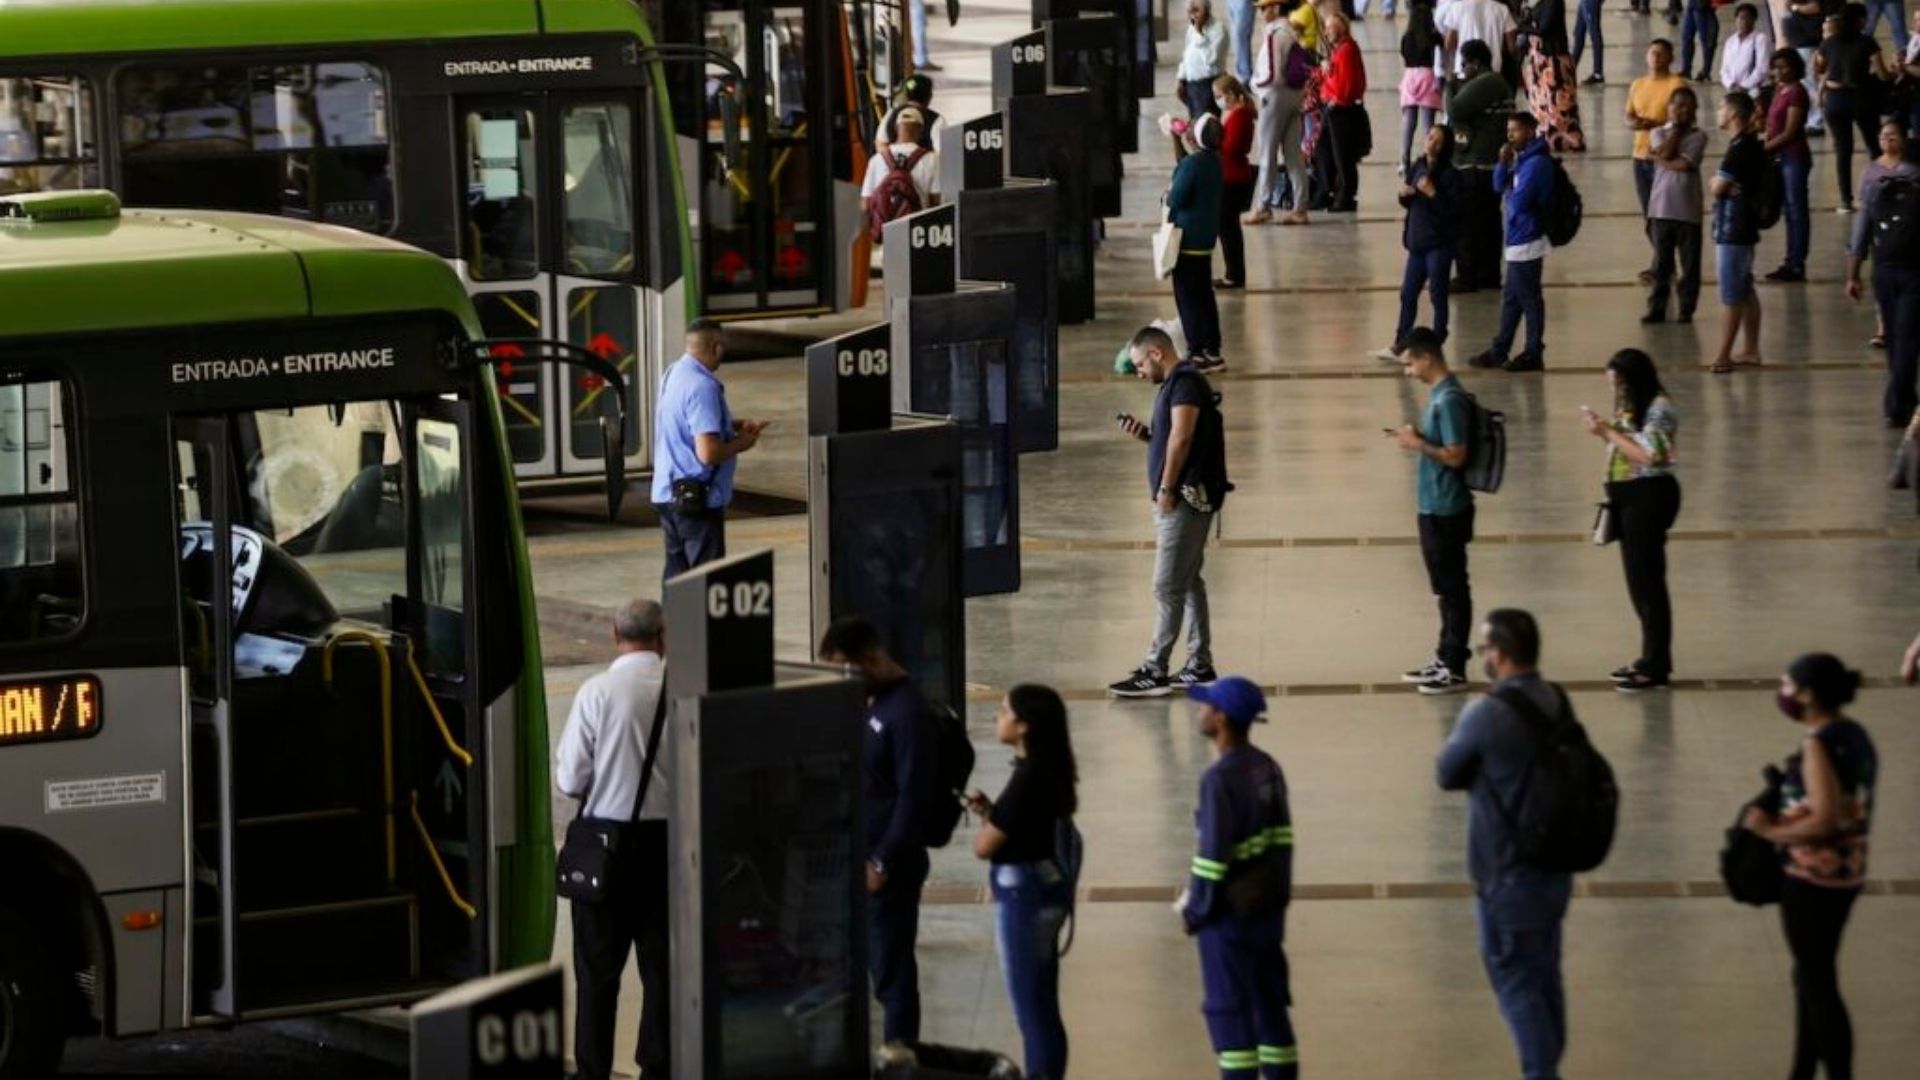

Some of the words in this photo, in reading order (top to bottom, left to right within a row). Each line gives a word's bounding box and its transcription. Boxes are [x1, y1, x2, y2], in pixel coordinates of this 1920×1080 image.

[444, 60, 511, 76] ENTRADA
[517, 56, 592, 73] ENTRANCE
[1012, 45, 1023, 63] C
[1025, 44, 1045, 62] 06
[965, 130, 977, 150] C
[980, 129, 1002, 149] 05
[912, 226, 925, 248] C
[928, 224, 953, 247] 04
[171, 357, 270, 382] ENTRADA
[283, 348, 394, 374] ENTRANCE
[838, 350, 853, 376] C
[859, 348, 888, 375] 03
[708, 583, 728, 617] C
[733, 581, 770, 616] 02
[0, 686, 43, 735] AN
[478, 1015, 506, 1061] C
[513, 1008, 558, 1059] 01
